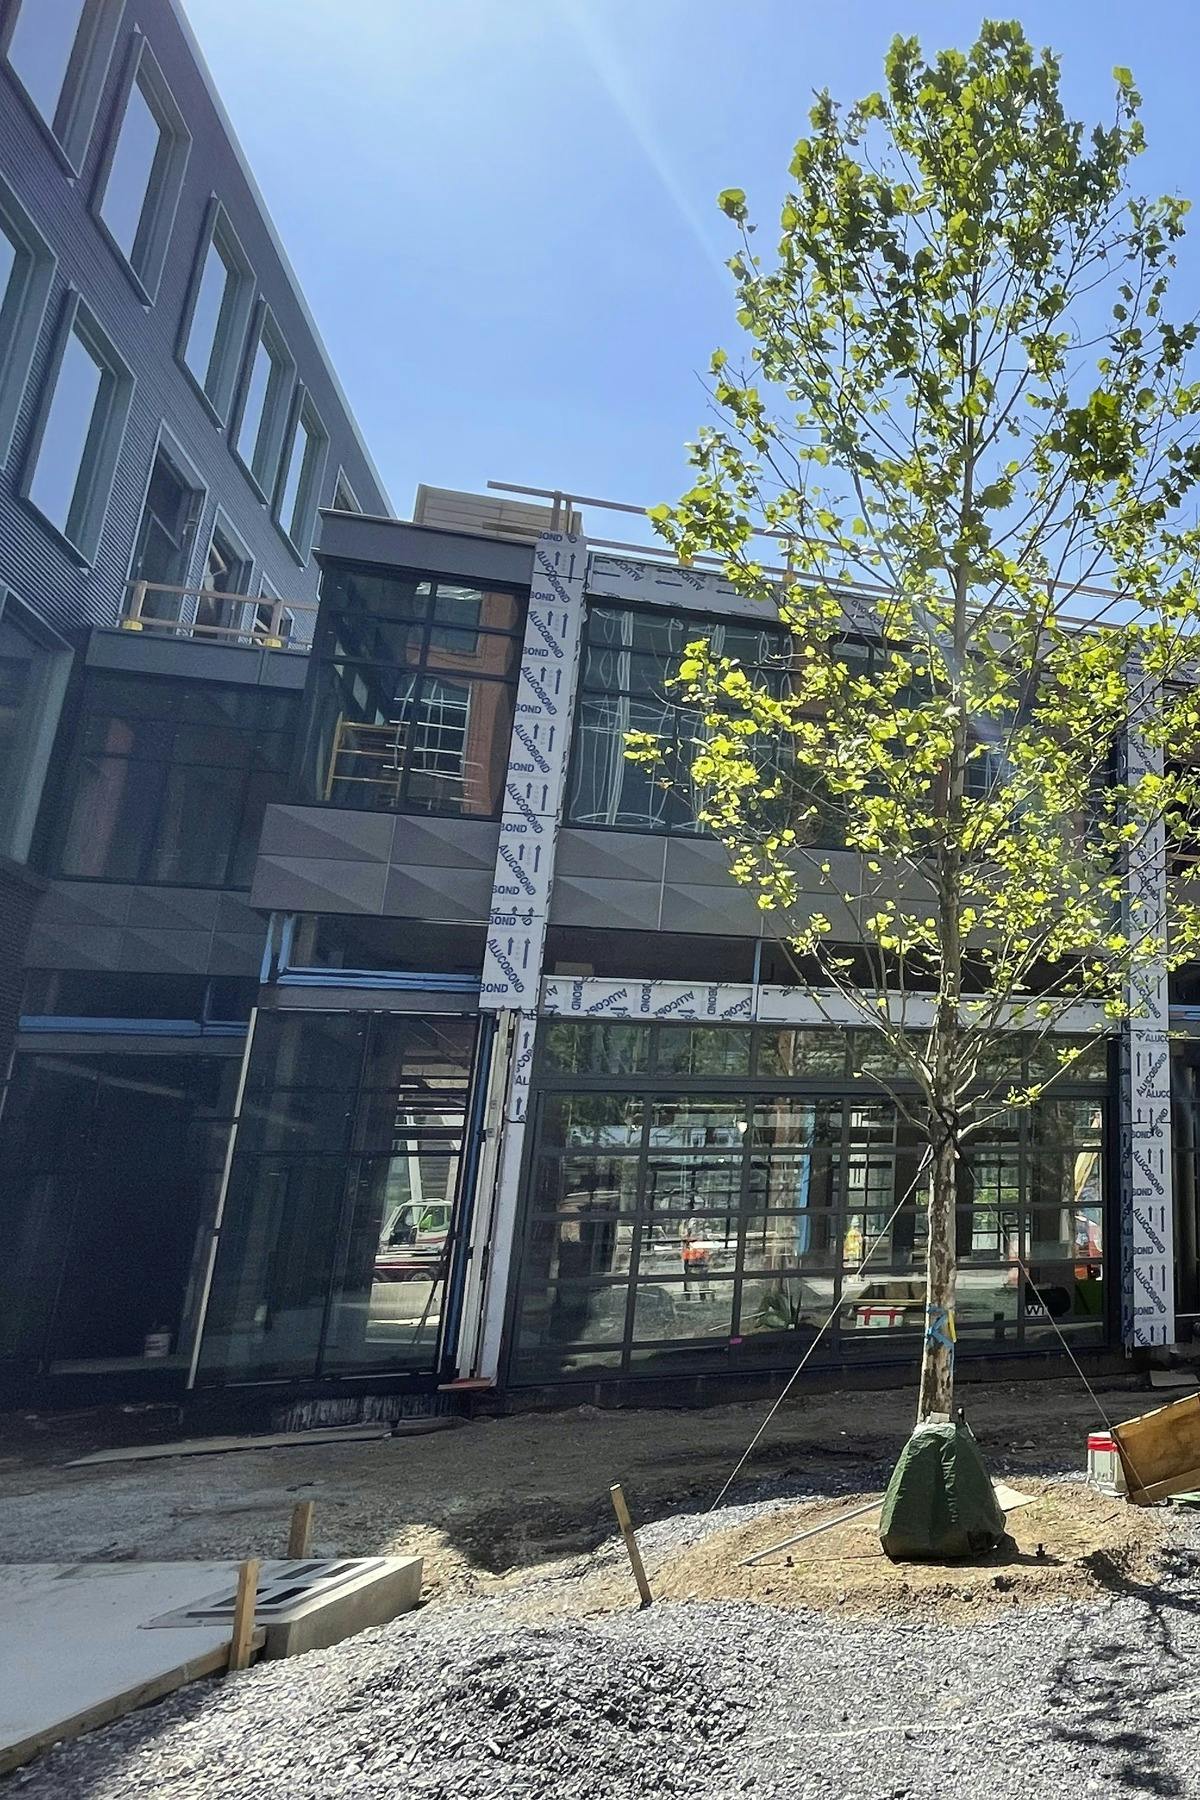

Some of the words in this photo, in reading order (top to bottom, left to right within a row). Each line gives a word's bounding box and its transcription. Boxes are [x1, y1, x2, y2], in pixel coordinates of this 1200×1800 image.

[528, 610, 564, 659] ALUCOBOND
[520, 666, 558, 716] ALUCOBOND
[513, 723, 551, 774] ALUCOBOND
[506, 782, 544, 834] ALUCOBOND
[498, 843, 537, 896] ALUCOBOND
[486, 938, 525, 994] ALUCOBOND
[1132, 1149, 1165, 1196] ALUCOBOND
[1132, 1207, 1166, 1254] ALUCOBOND
[1133, 1266, 1167, 1314] ALUCOBOND
